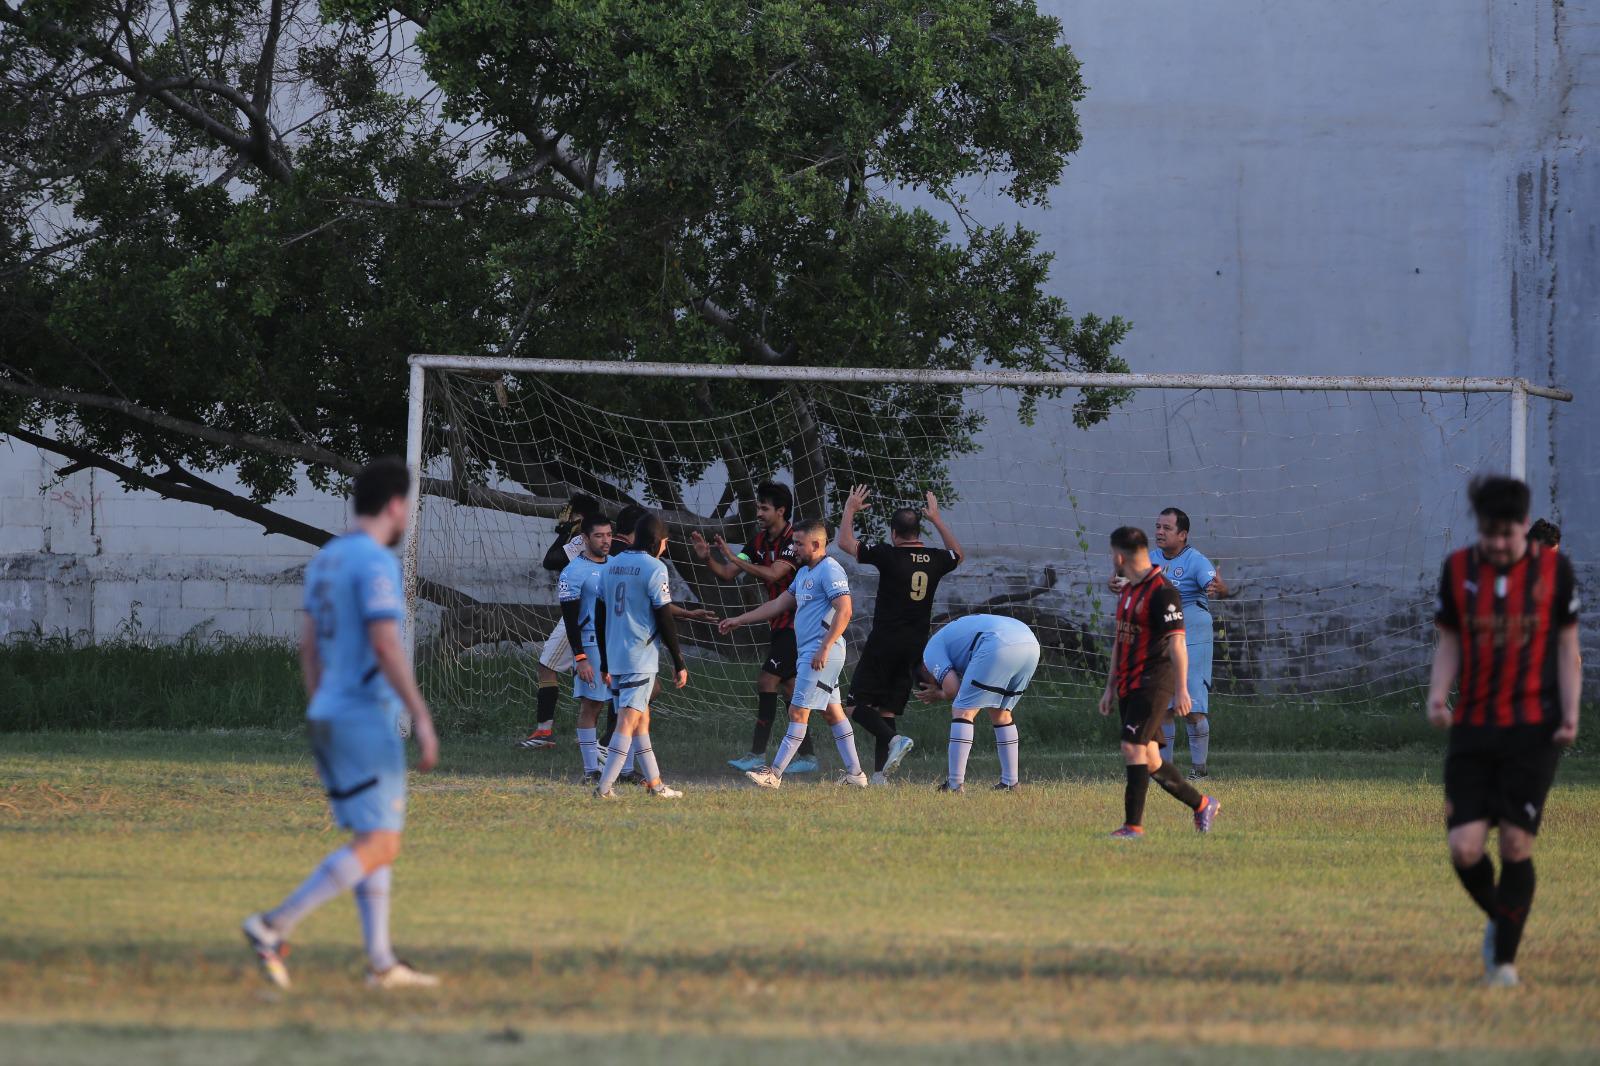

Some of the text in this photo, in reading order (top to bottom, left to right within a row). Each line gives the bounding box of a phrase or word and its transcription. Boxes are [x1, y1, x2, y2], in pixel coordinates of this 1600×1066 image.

[910, 552, 930, 562] TEO
[909, 571, 929, 601] 9
[615, 581, 626, 617] 9
[1163, 612, 1184, 622] MSC
